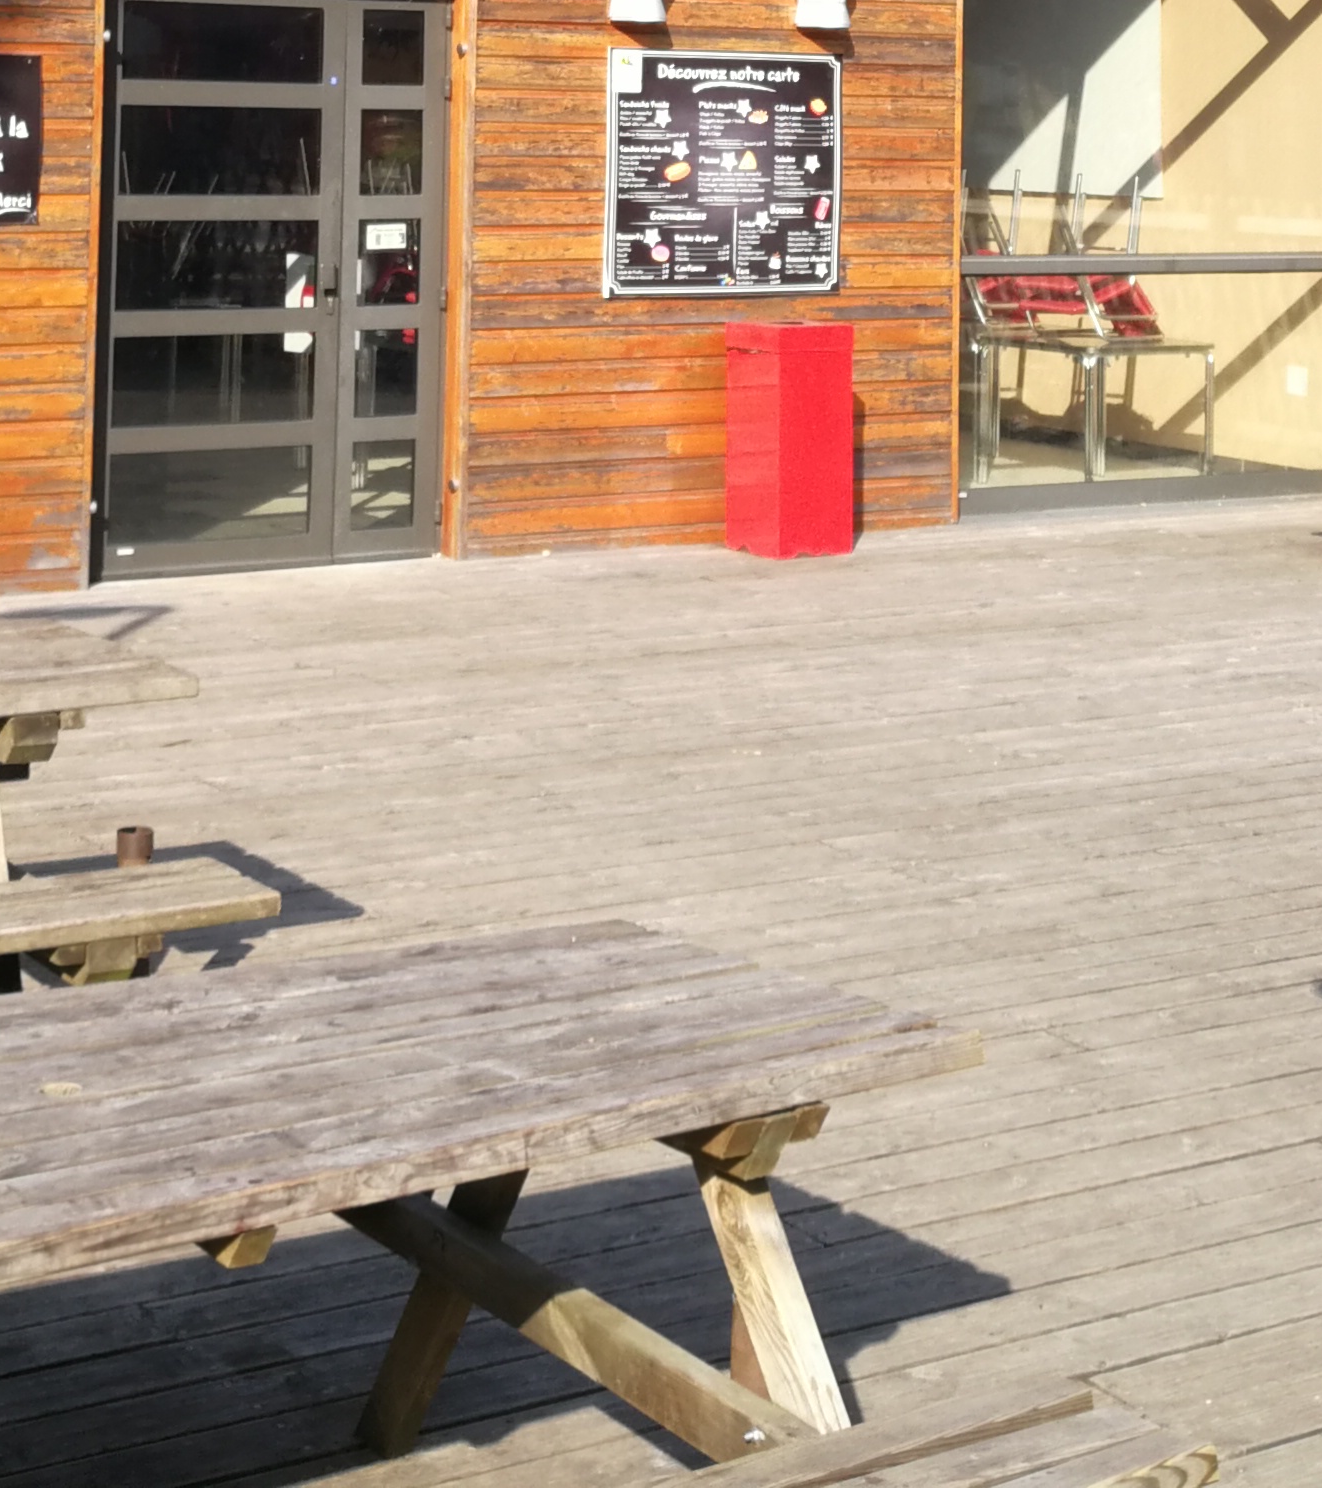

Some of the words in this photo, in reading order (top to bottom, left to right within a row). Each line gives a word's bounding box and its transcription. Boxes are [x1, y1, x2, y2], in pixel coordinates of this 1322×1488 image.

[657, 63, 727, 80] Découvrez
[730, 65, 765, 82] notre
[768, 67, 800, 82] carte
[9, 115, 29, 139] la
